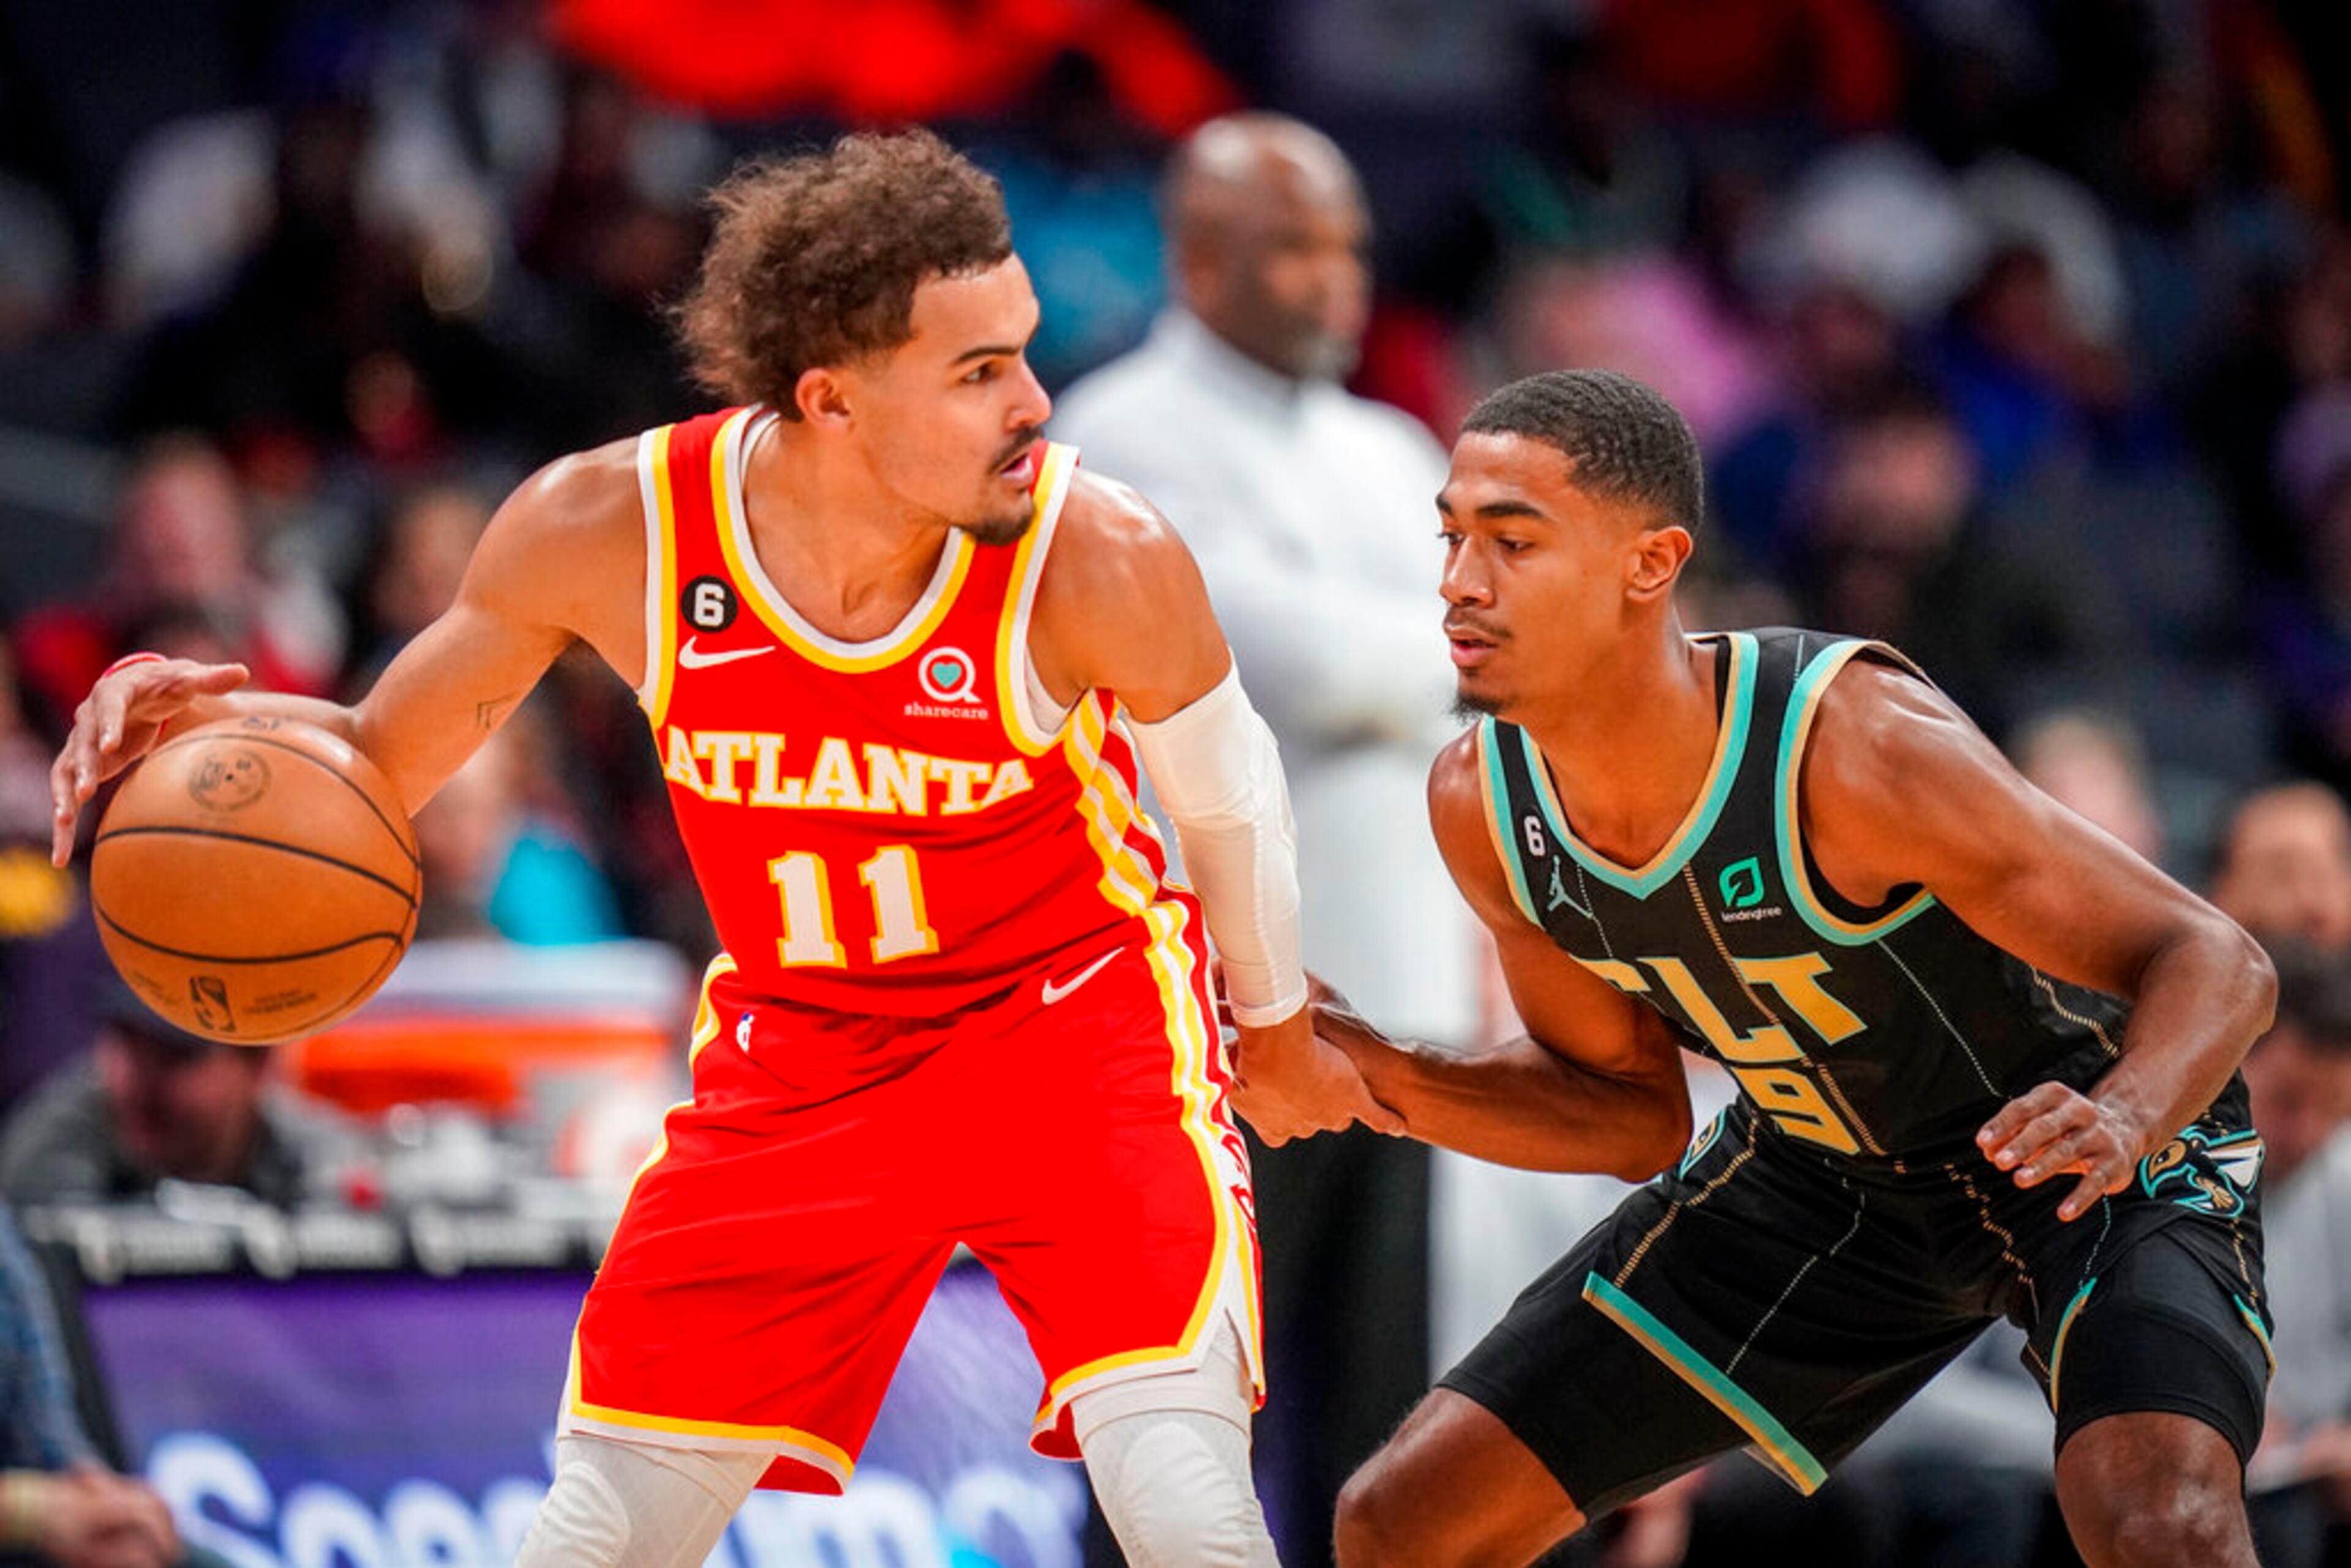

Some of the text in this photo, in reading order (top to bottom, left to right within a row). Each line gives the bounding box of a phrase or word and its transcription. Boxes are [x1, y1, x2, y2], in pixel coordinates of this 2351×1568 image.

[694, 582, 724, 627] 6
[904, 701, 989, 720] sharecare
[664, 725, 1034, 817] ATLANTA
[1524, 815, 1546, 856] 6
[767, 844, 940, 969] 11
[1730, 1067, 1861, 1156] 9
